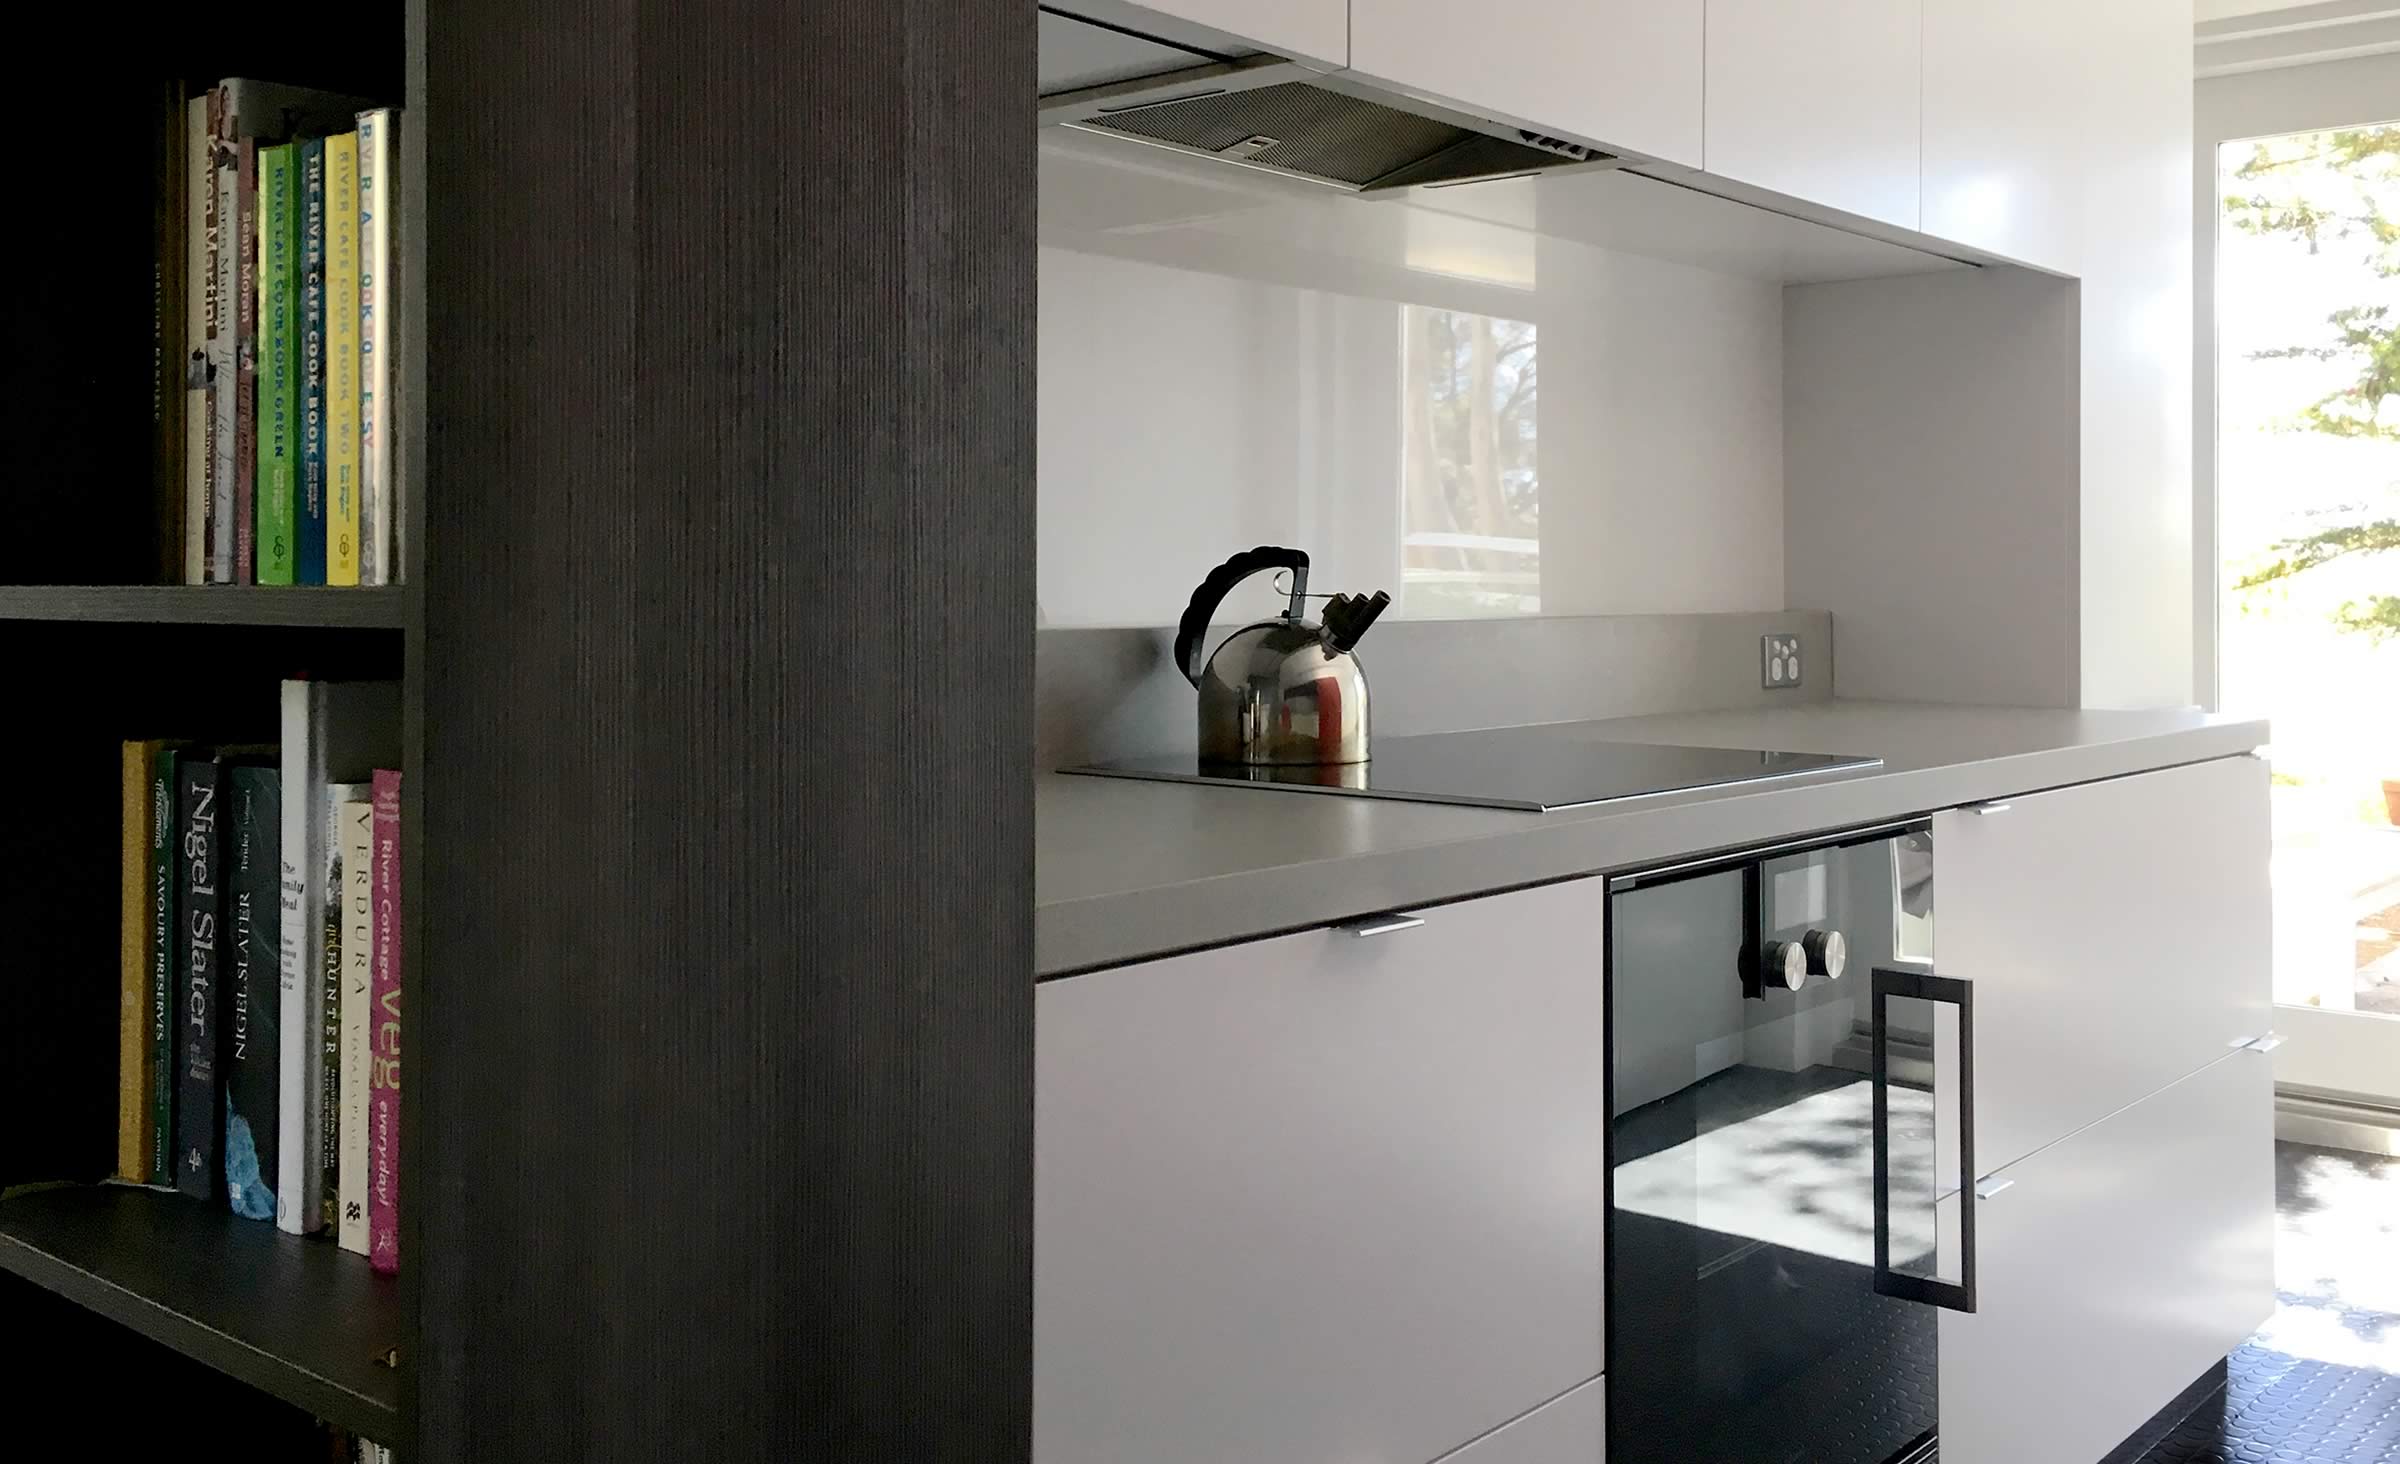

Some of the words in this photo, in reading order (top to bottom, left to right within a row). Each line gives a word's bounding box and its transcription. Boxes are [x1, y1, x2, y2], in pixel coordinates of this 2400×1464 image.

[274, 168, 285, 223] RIVER
[308, 152, 321, 193] THE
[339, 151, 350, 211] RIVER
[220, 190, 230, 248] Karen
[241, 211, 252, 257] Sean
[308, 202, 321, 263] RIVER
[219, 257, 230, 332] Martini
[241, 263, 252, 323] Moran
[274, 280, 285, 331] COOK
[339, 278, 350, 334] COOK
[274, 337, 285, 390] BOOK
[307, 331, 319, 388] COOK
[339, 344, 350, 400] BOOK
[274, 397, 285, 457] GREEN
[307, 396, 319, 455] BOOK
[184, 782, 215, 895] Nigel
[241, 832, 250, 871] Tender
[381, 839, 392, 893] River
[156, 864, 166, 942] SAVOURY
[355, 811, 370, 994] VERDURA
[237, 891, 250, 981] SLATER
[379, 898, 392, 981] Cottage
[155, 951, 165, 1041] PRESERVES
[189, 909, 214, 1036] Slater
[325, 950, 337, 1054] HUNTER
[235, 987, 247, 1061] NIGEL
